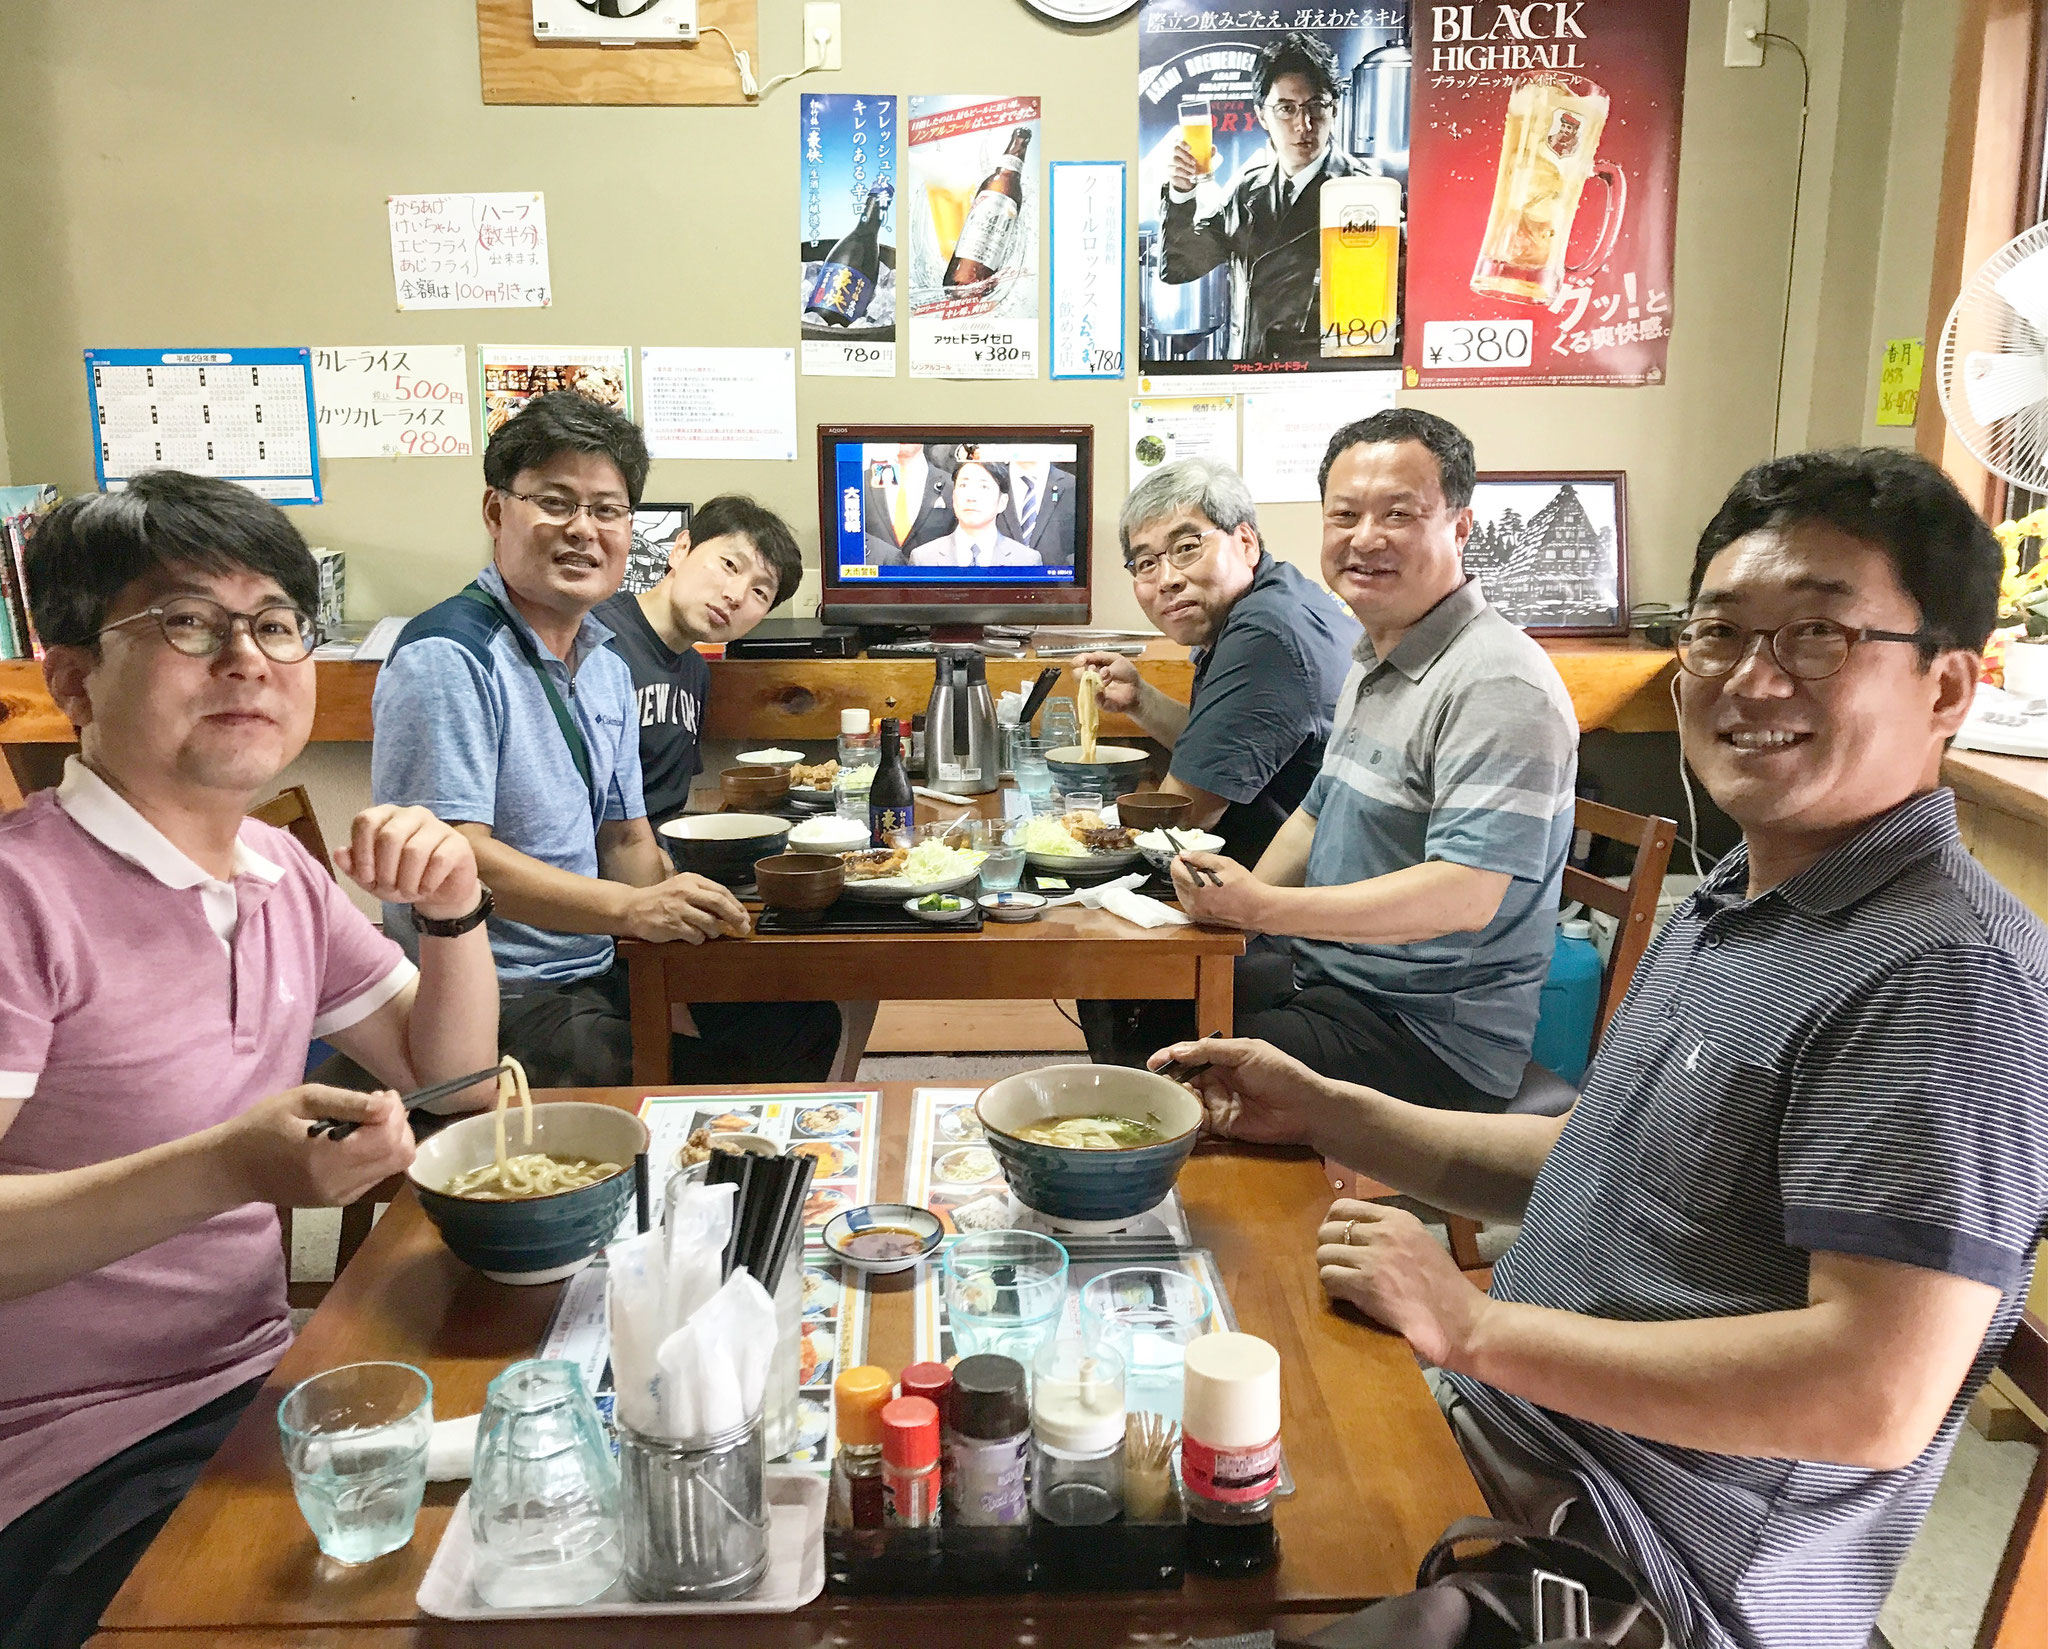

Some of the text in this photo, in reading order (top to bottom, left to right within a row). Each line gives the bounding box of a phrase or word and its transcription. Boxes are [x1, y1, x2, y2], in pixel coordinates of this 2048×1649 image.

[1431, 2, 1587, 42] BLACK
[1432, 44, 1585, 72] HIGHBALL
[1431, 74, 1514, 88] ブラックニッカ
[851, 100, 869, 223] キレのある辛口。
[876, 100, 893, 233] フレッシュな香り、
[394, 197, 452, 216] からあげ
[481, 205, 529, 222] ハーフ
[395, 218, 461, 234] けいちゃん
[1343, 219, 1377, 234] Asahi
[398, 239, 467, 254] エビフライ
[1082, 176, 1098, 308] クールロックス
[399, 258, 470, 275] あじフライ
[1549, 271, 1668, 331] グッ!と
[934, 333, 1013, 344] アサヒドライゼロ
[1430, 327, 1528, 364] ¥380
[1551, 316, 1670, 357] くる爽快感。
[315, 350, 411, 373] カレーライス
[1089, 350, 1123, 373] ¥780
[1233, 362, 1309, 373] アサヒスーパードライ
[395, 375, 464, 405] 500円
[318, 406, 445, 428] カツカレーライス
[400, 429, 470, 455] 980円
[672, 686, 701, 745] OR
